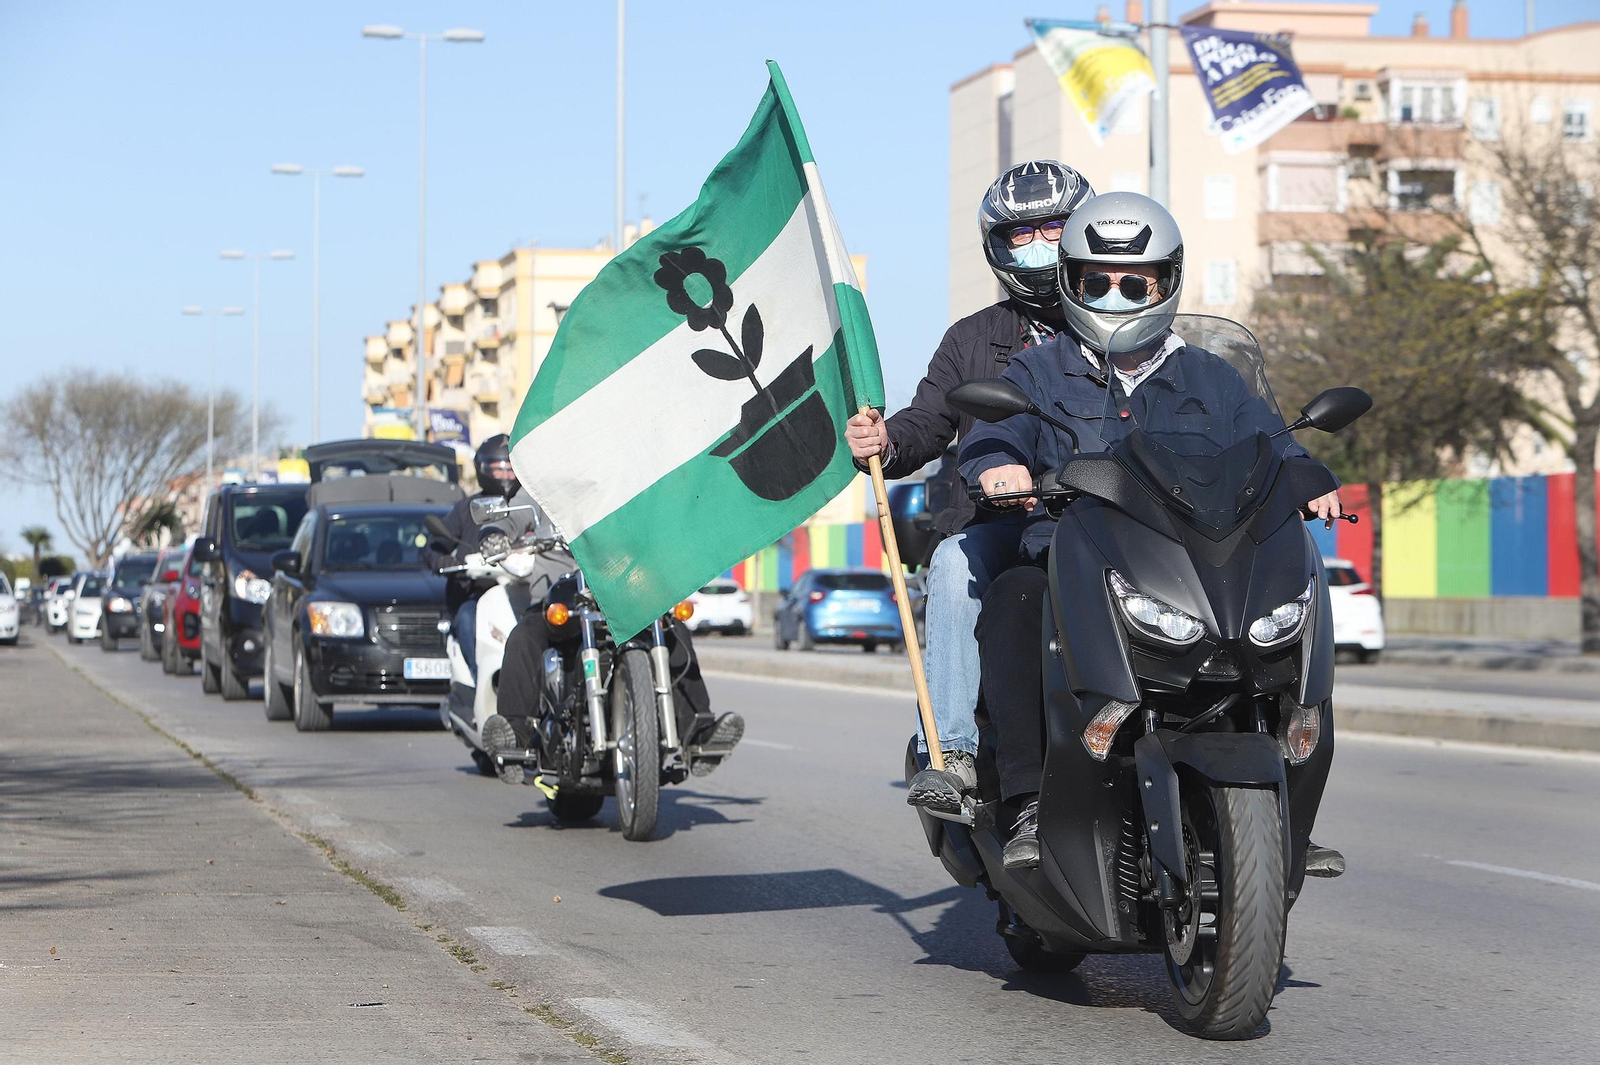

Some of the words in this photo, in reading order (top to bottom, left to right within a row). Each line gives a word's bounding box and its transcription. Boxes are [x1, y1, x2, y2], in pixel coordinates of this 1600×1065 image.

[1193, 36, 1225, 56] DE
[1199, 42, 1256, 71] POLO
[1207, 66, 1223, 86] A
[1220, 51, 1278, 76] POLO
[1014, 198, 1053, 212] SHIRO
